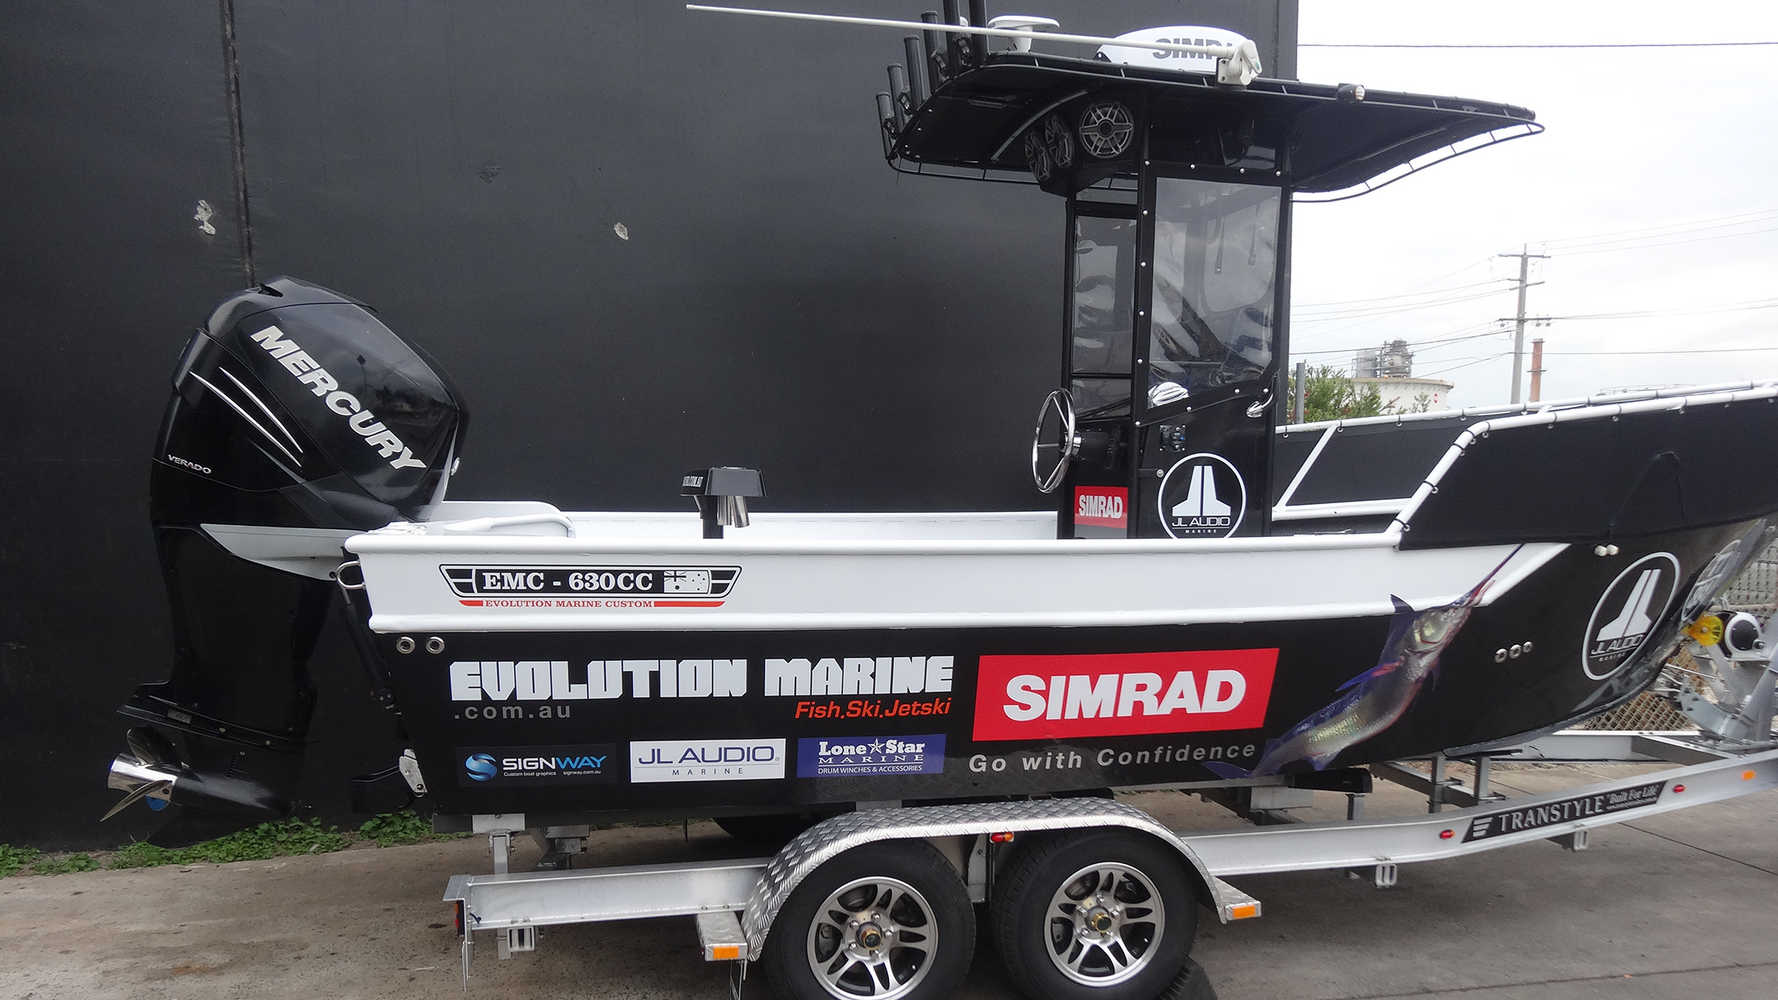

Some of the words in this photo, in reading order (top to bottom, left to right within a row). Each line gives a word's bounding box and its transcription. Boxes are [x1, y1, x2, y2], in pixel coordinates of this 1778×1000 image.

[1153, 38, 1233, 60] SIMR
[250, 325, 427, 470] MERCURY
[168, 454, 211, 474] VERADO
[1079, 495, 1123, 518] SIMRAD
[1172, 518, 1187, 526] JL
[1189, 517, 1230, 526] AUDIO
[482, 572, 544, 590] EMC
[568, 572, 653, 590] 630CC
[485, 599, 552, 608] EVOLUTION
[556, 599, 601, 607] MARINE
[605, 599, 652, 607] CUSTOM
[449, 659, 748, 701] EVOLUTION
[764, 656, 954, 697] MARINE
[1003, 669, 1247, 722] SIMRAD
[454, 705, 571, 720] .com.au
[638, 748, 673, 764] JL
[679, 746, 775, 763] AUDIO
[818, 741, 866, 756] Lone
[885, 739, 925, 753] Star
[502, 755, 607, 770] SIGNWAY
[818, 754, 924, 764] MARINE
[969, 754, 1006, 773] Go
[1022, 752, 1082, 770] with
[1097, 743, 1255, 766] Confidence
[672, 767, 744, 776] MARINE
[840, 766, 871, 774] WINCHES
[879, 765, 922, 773] ACCESSORIES
[1499, 795, 1605, 832] TRANSTYLE
